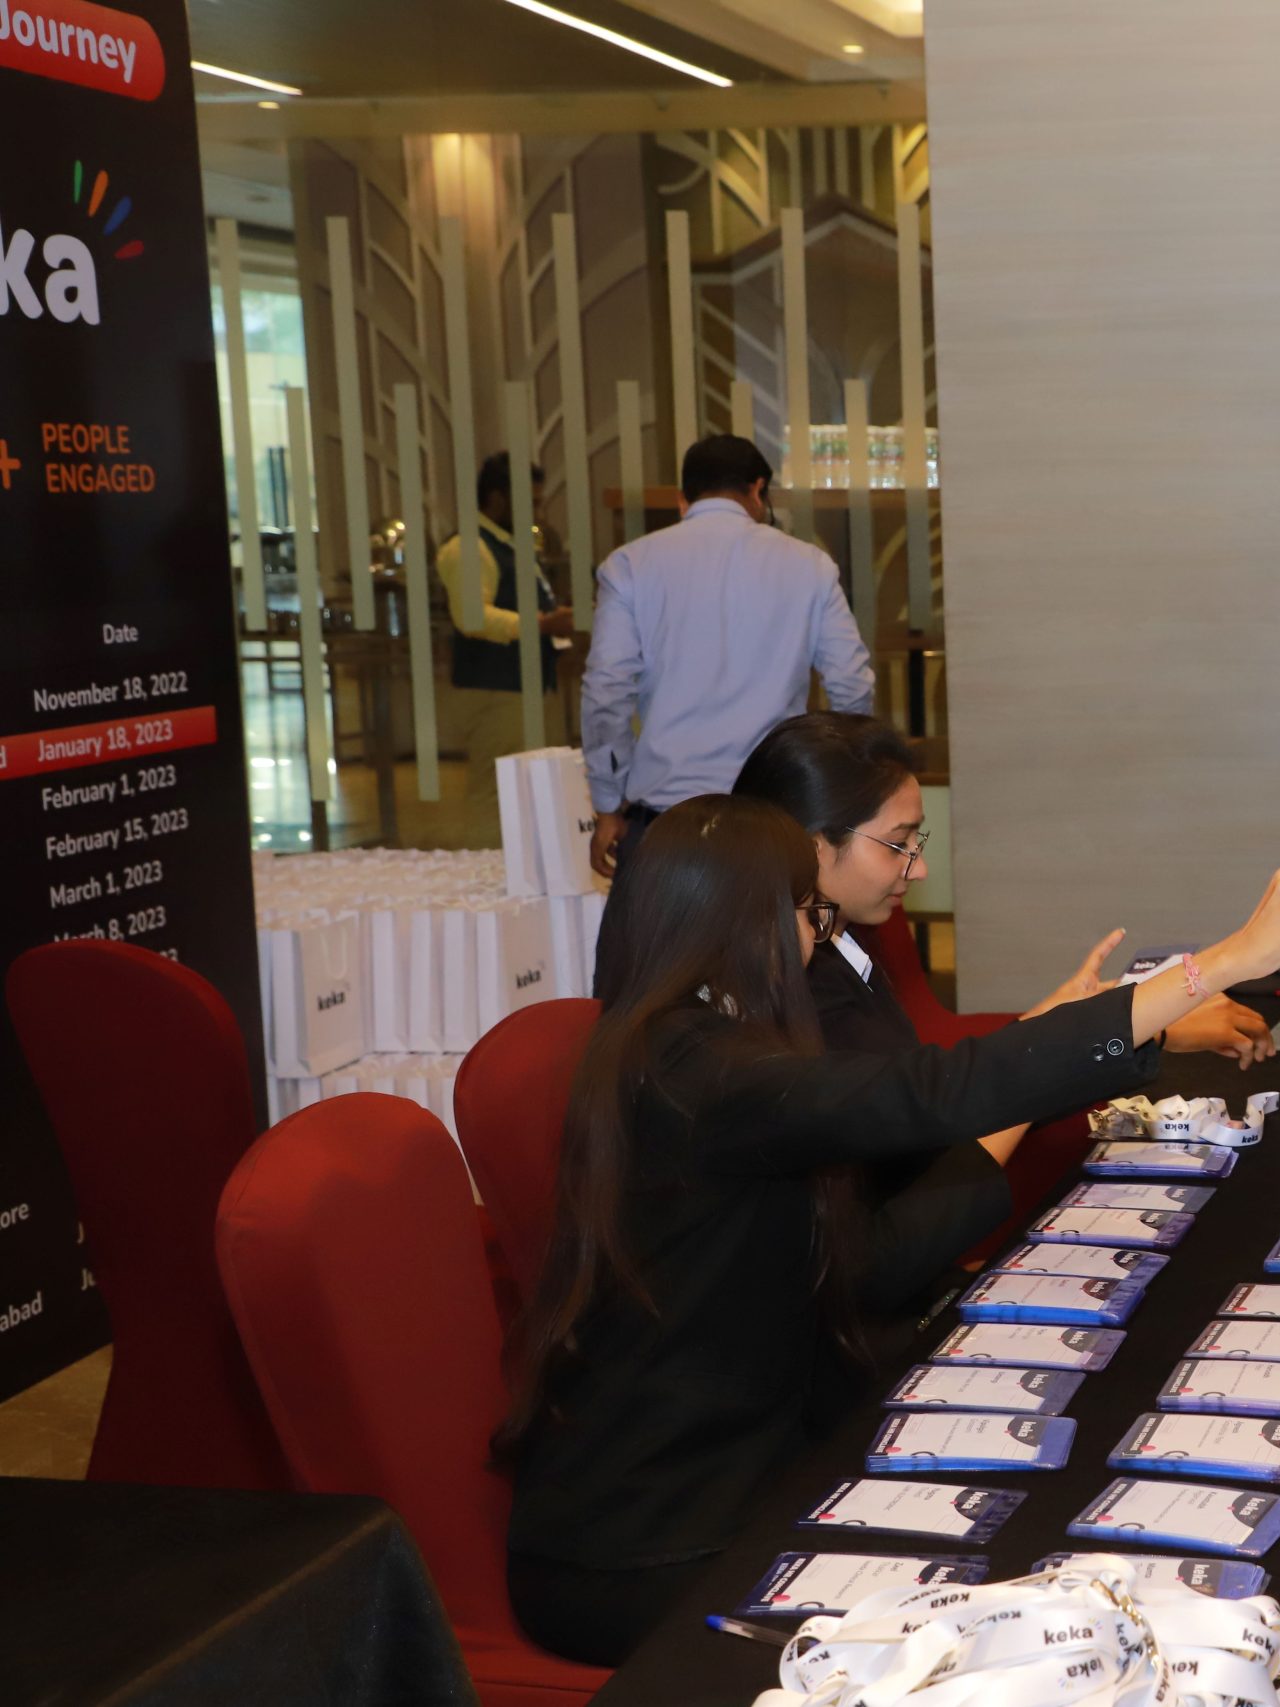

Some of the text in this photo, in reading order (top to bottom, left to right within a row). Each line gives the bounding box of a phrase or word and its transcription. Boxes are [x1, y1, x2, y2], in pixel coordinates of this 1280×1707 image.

[0, 0, 136, 83] Journey
[42, 423, 130, 454] PEOPLE
[45, 463, 155, 494] ENGAGED
[103, 624, 139, 644] Date
[34, 671, 188, 712] November 18, 2022
[38, 737, 102, 763] January
[107, 727, 132, 750] 18,
[135, 719, 174, 746] 2023
[42, 765, 177, 811] February 1, 2023
[46, 808, 189, 859] February 15, 2023
[50, 860, 163, 908] March 1, 2023
[127, 905, 166, 936] 2023
[1165, 1123, 1189, 1132] keka
[1018, 1420, 1037, 1438] keka
[962, 1491, 989, 1510] keka
[1239, 1497, 1265, 1516] keka
[1191, 1564, 1210, 1584] keka
[930, 1592, 970, 1608] keka
[1044, 1625, 1094, 1645] keka
